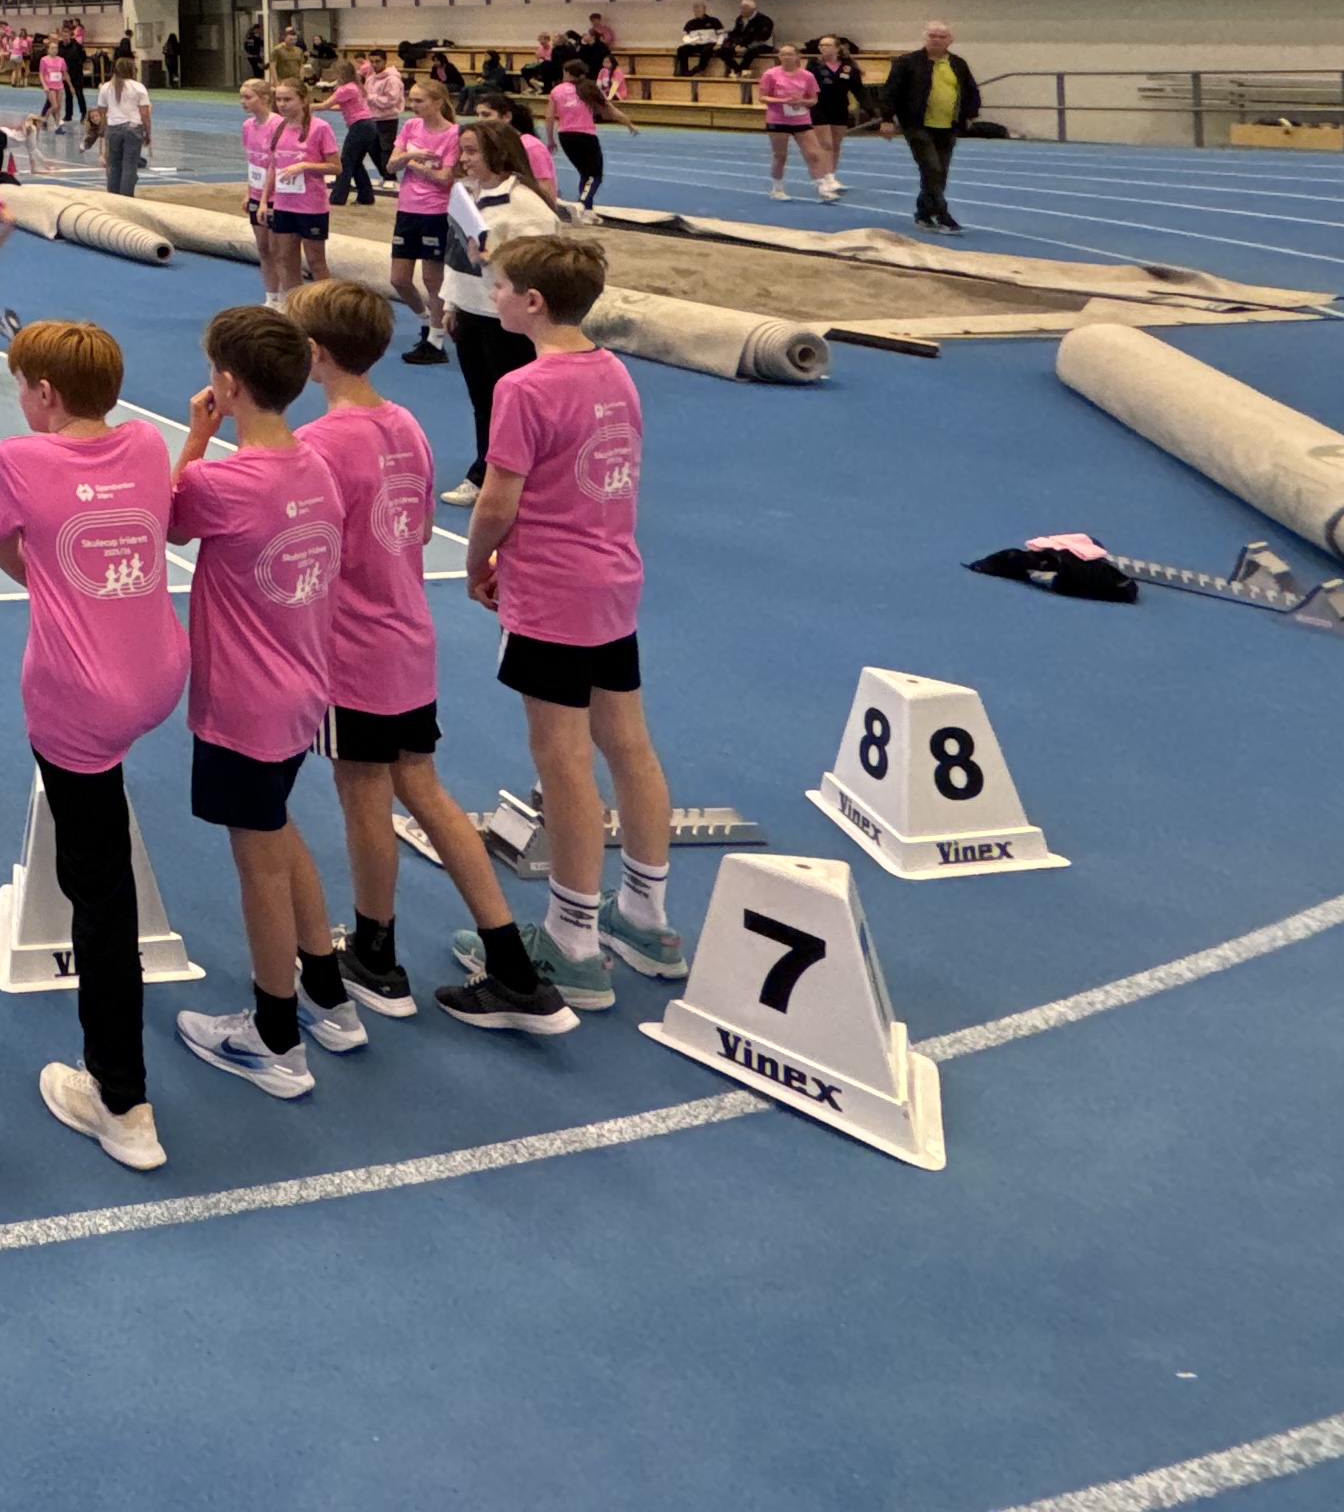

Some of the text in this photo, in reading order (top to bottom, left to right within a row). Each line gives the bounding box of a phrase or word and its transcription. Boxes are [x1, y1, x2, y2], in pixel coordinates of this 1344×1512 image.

[859, 707, 891, 780] 8
[929, 726, 984, 801] 8
[838, 790, 882, 847] Vinex
[936, 839, 1014, 865] Vinex
[743, 908, 827, 1015] 7
[715, 1025, 843, 1113] Vinex
